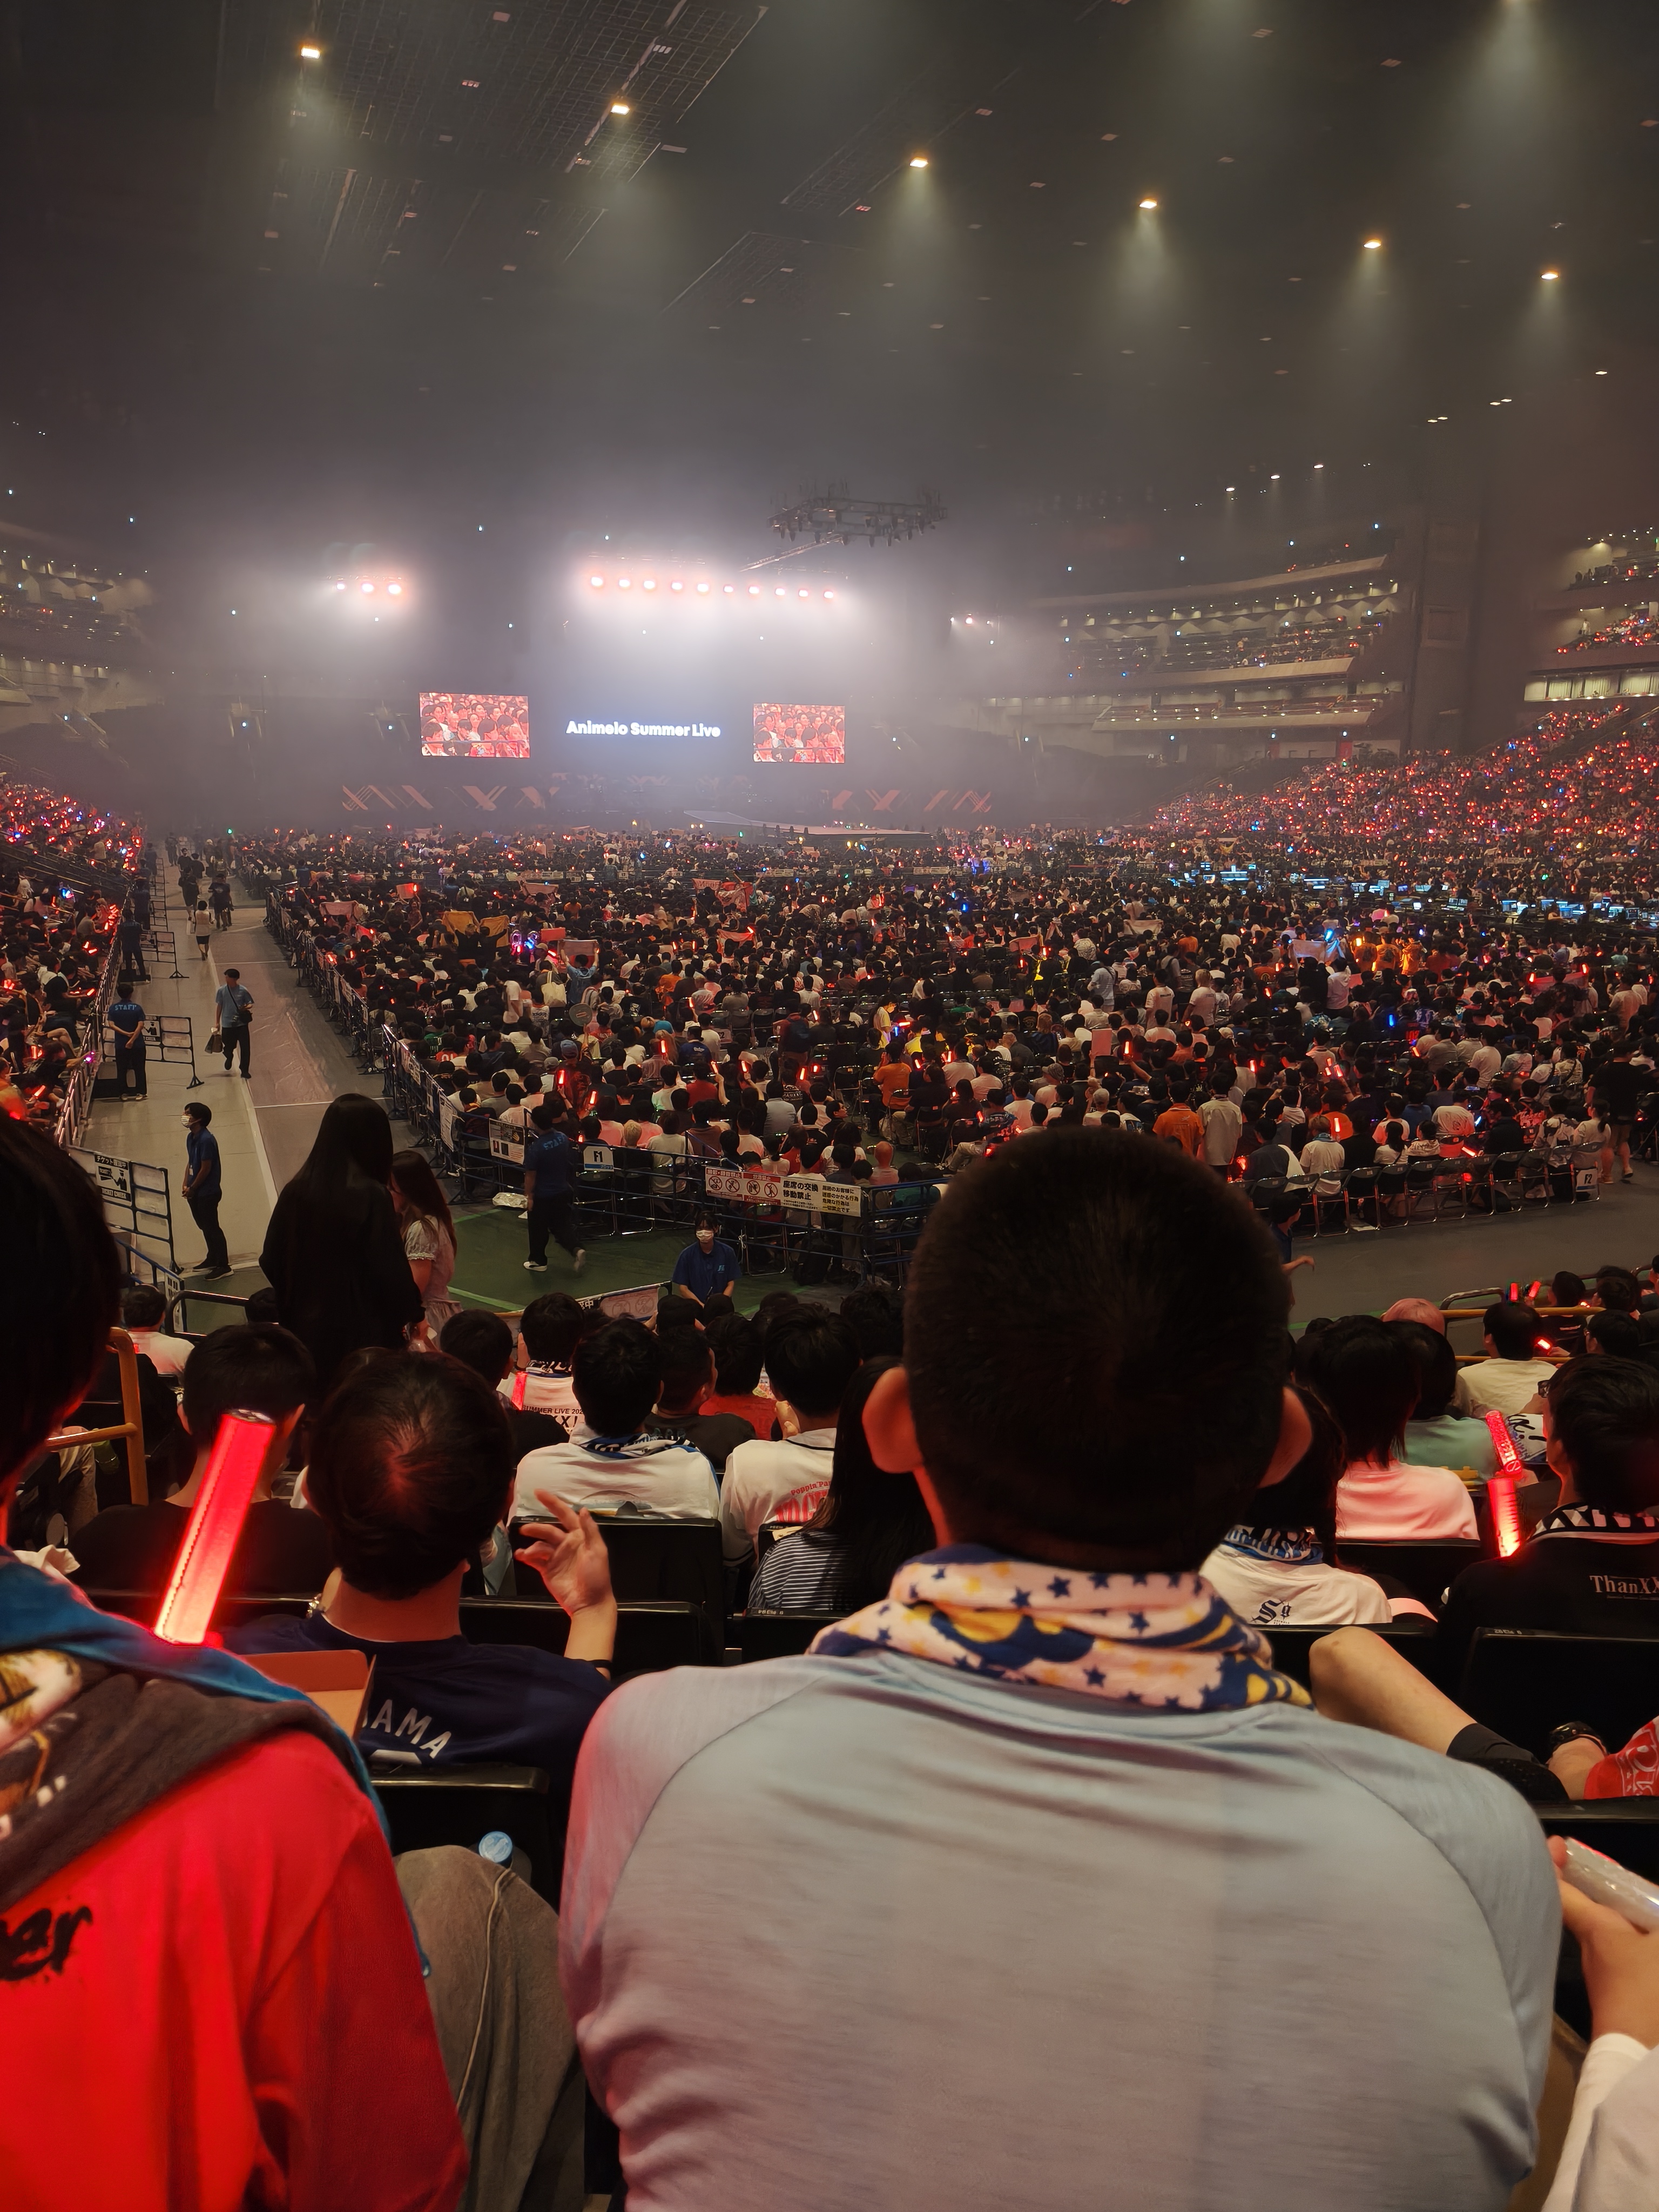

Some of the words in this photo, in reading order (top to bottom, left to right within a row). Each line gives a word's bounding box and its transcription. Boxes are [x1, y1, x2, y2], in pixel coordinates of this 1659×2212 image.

[566, 720, 628, 735] Animelo
[630, 722, 690, 736] Summer
[692, 723, 721, 737] Live
[1584, 1174, 1593, 1184] F2
[783, 1181, 819, 1192] 座席の交換
[783, 1190, 812, 1200] 移動禁止
[522, 1405, 552, 1414] SUMMER
[362, 1699, 451, 1759] AMA
